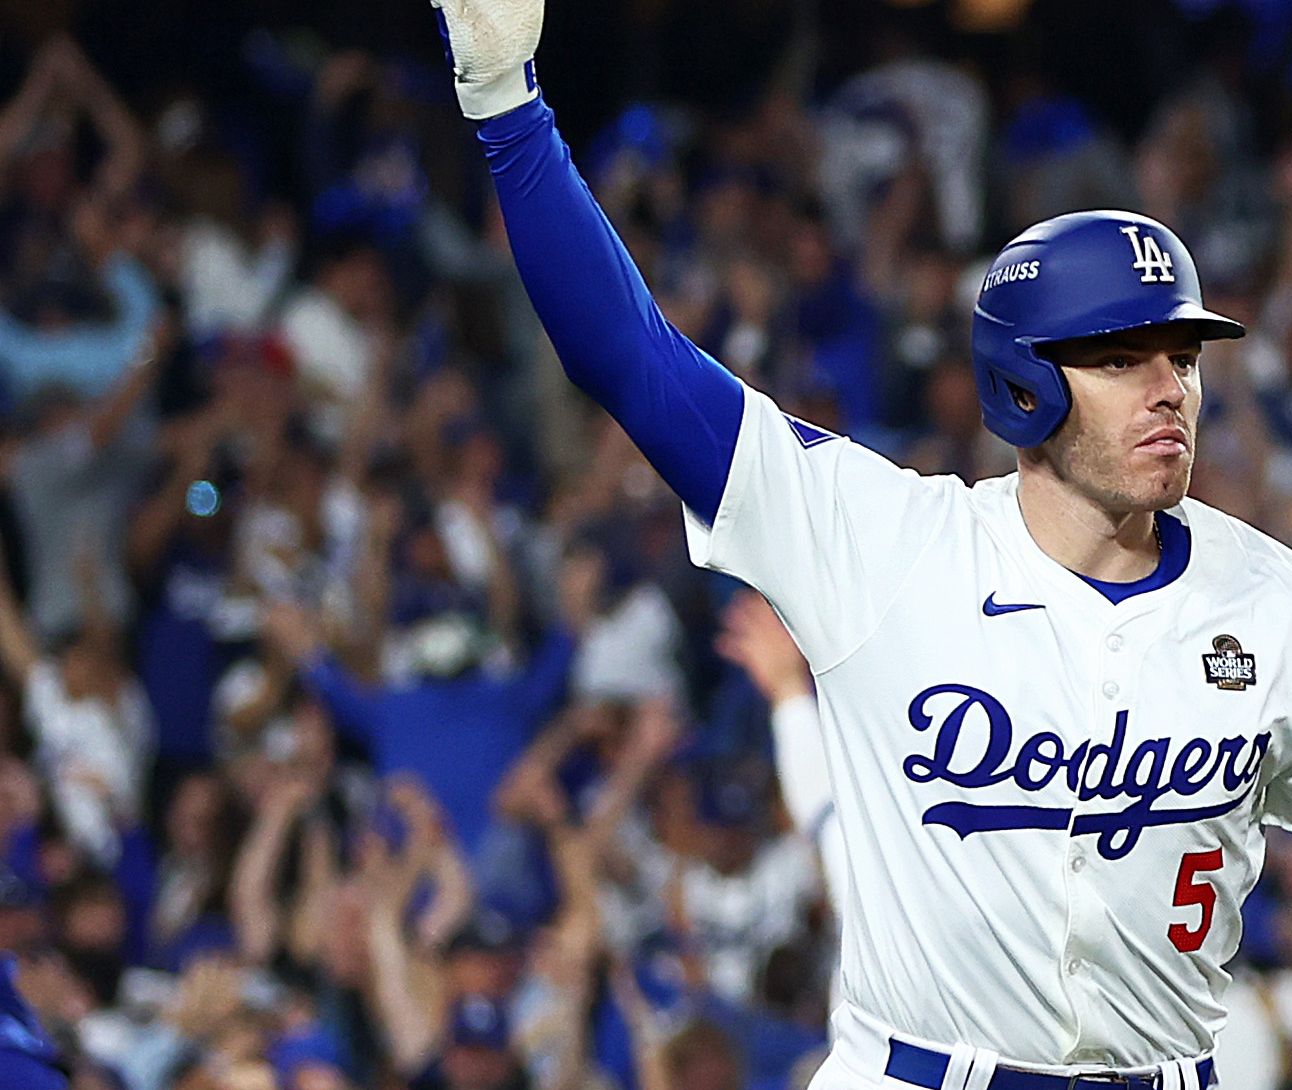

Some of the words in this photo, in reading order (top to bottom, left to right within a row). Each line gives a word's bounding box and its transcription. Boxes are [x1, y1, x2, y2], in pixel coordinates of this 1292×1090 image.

[1119, 226, 1175, 283] LA
[1205, 656, 1254, 669] WORLD
[1209, 666, 1253, 680] SERIES
[1167, 848, 1224, 953] 5
